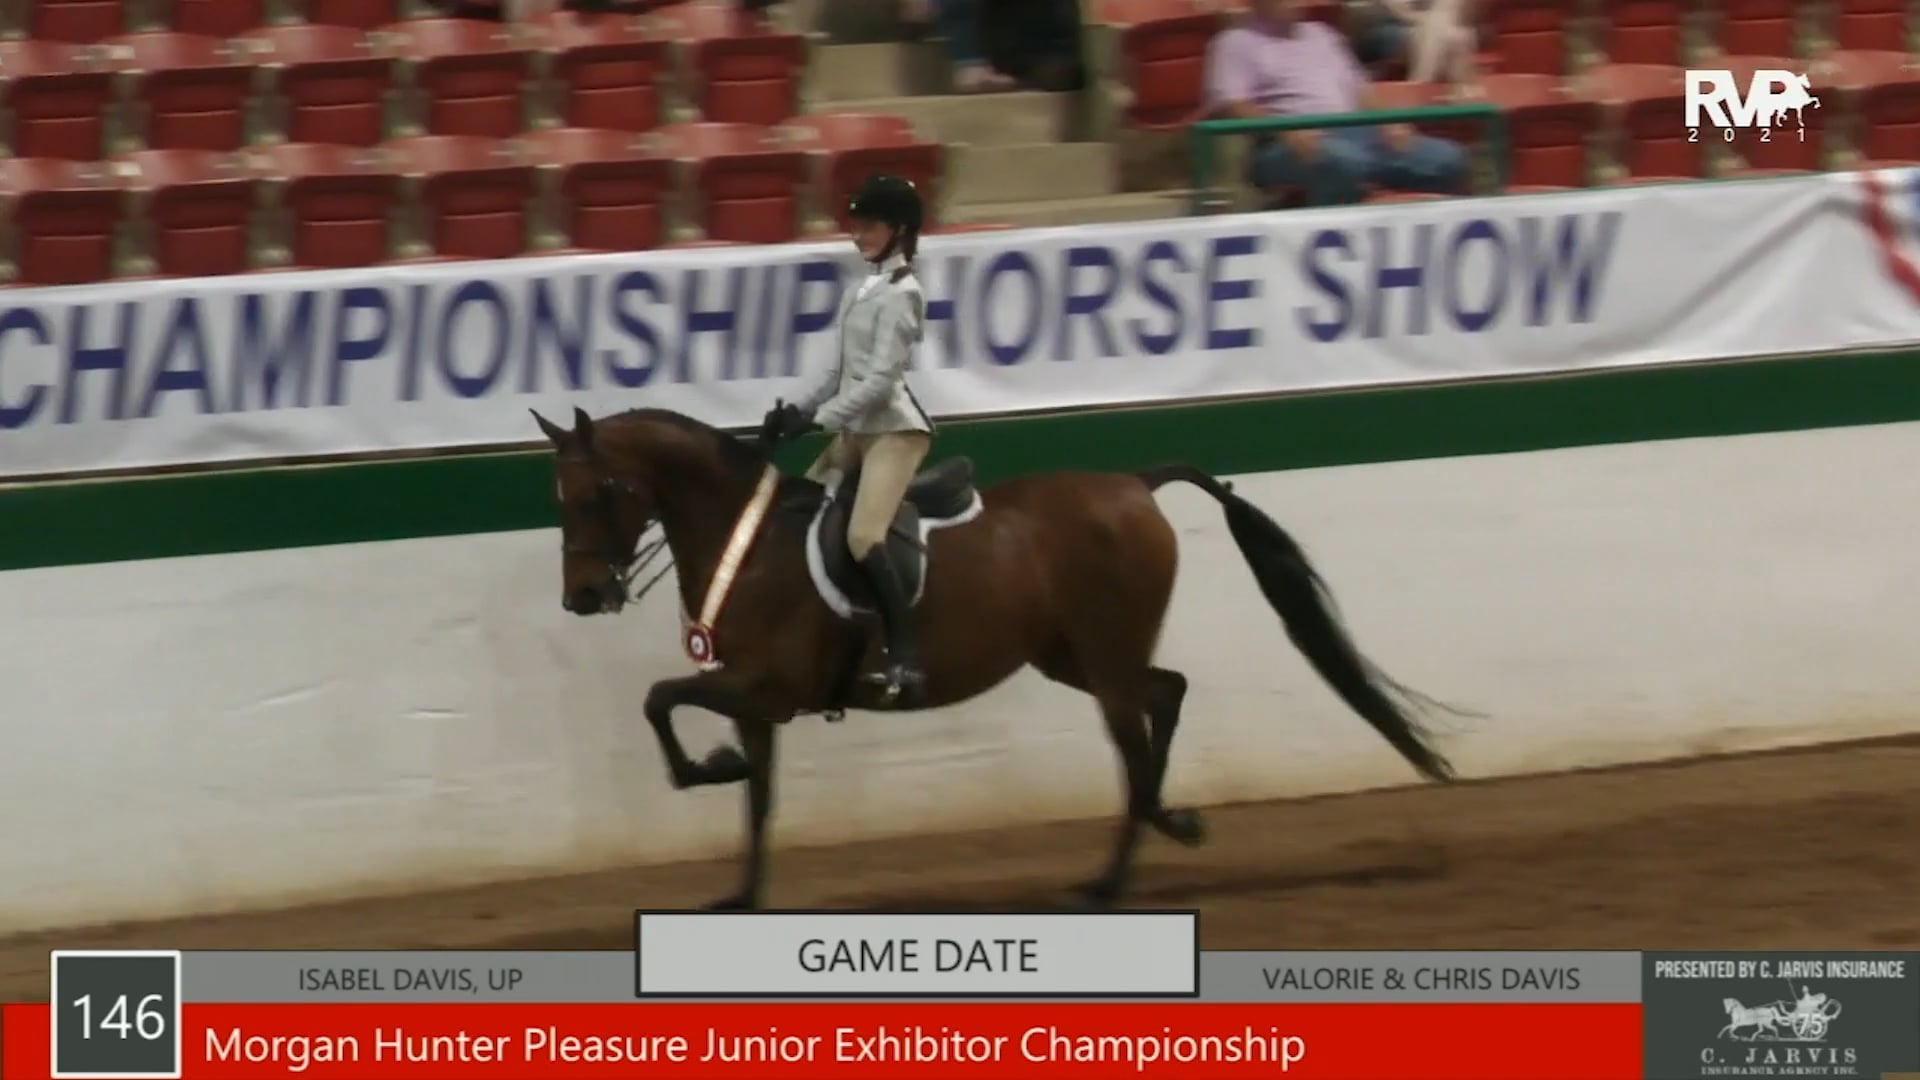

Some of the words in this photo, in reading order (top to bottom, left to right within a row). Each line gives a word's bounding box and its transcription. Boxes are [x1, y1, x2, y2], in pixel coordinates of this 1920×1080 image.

[0, 258, 842, 430] CHAMPIONSHIP
[906, 234, 1264, 372] HORSE
[1298, 211, 1626, 344] SHOW
